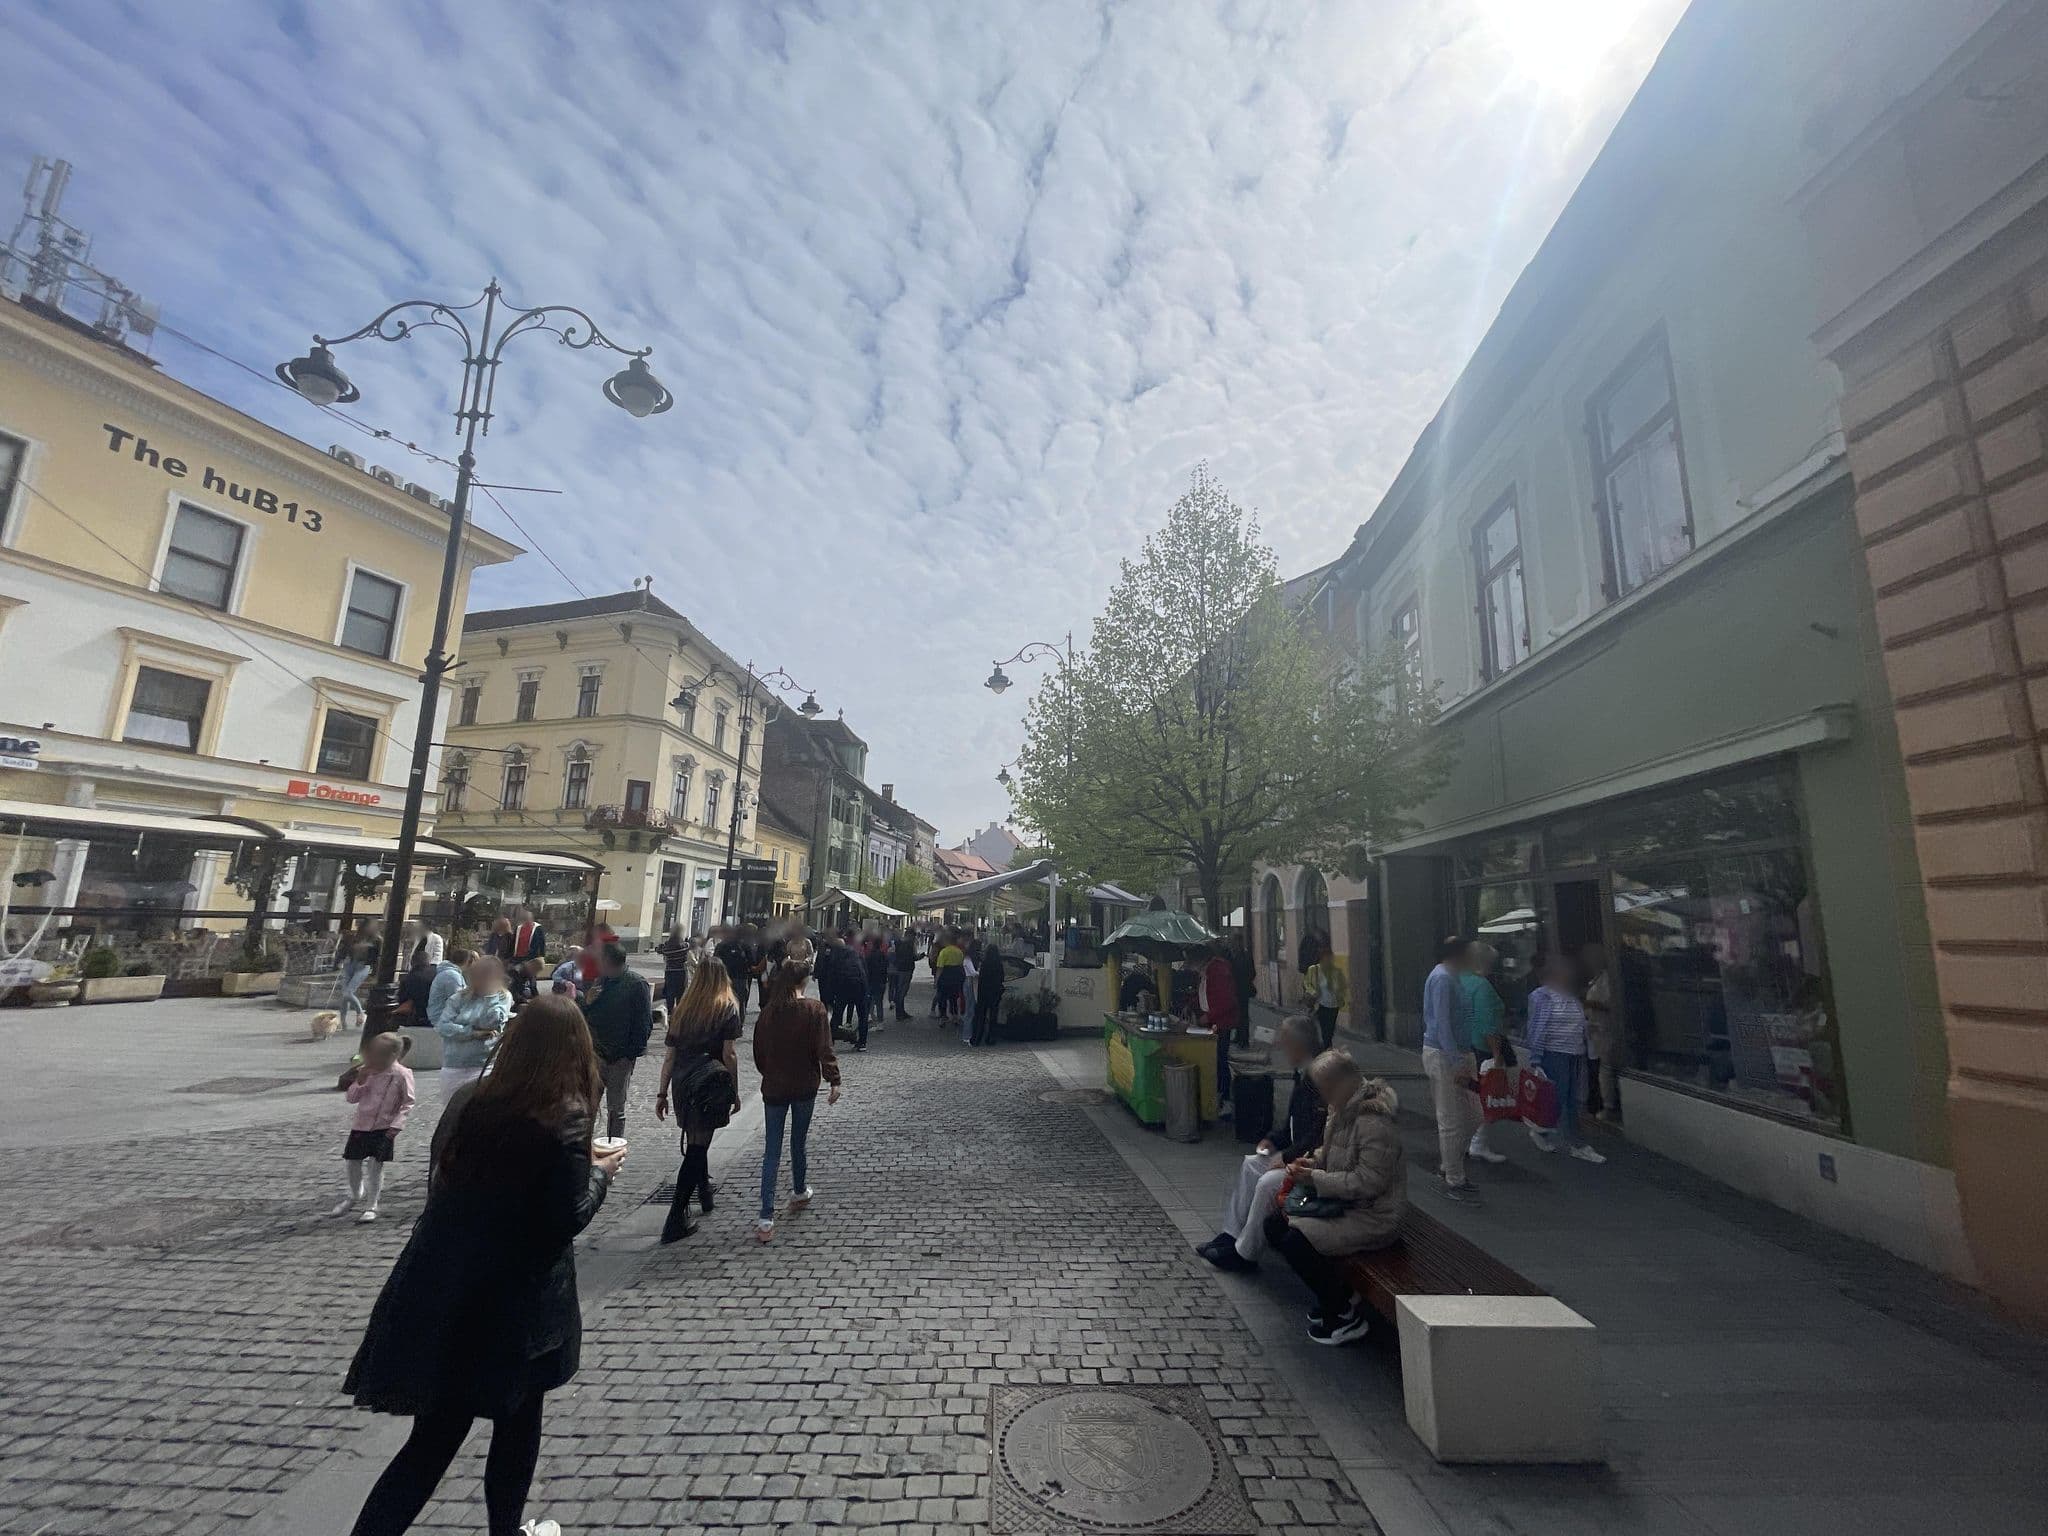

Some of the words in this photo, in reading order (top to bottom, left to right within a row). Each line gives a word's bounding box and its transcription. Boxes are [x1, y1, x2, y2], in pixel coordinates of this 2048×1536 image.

[103, 423, 188, 478] The
[202, 466, 323, 533] huB13
[316, 785, 381, 806] Orange
